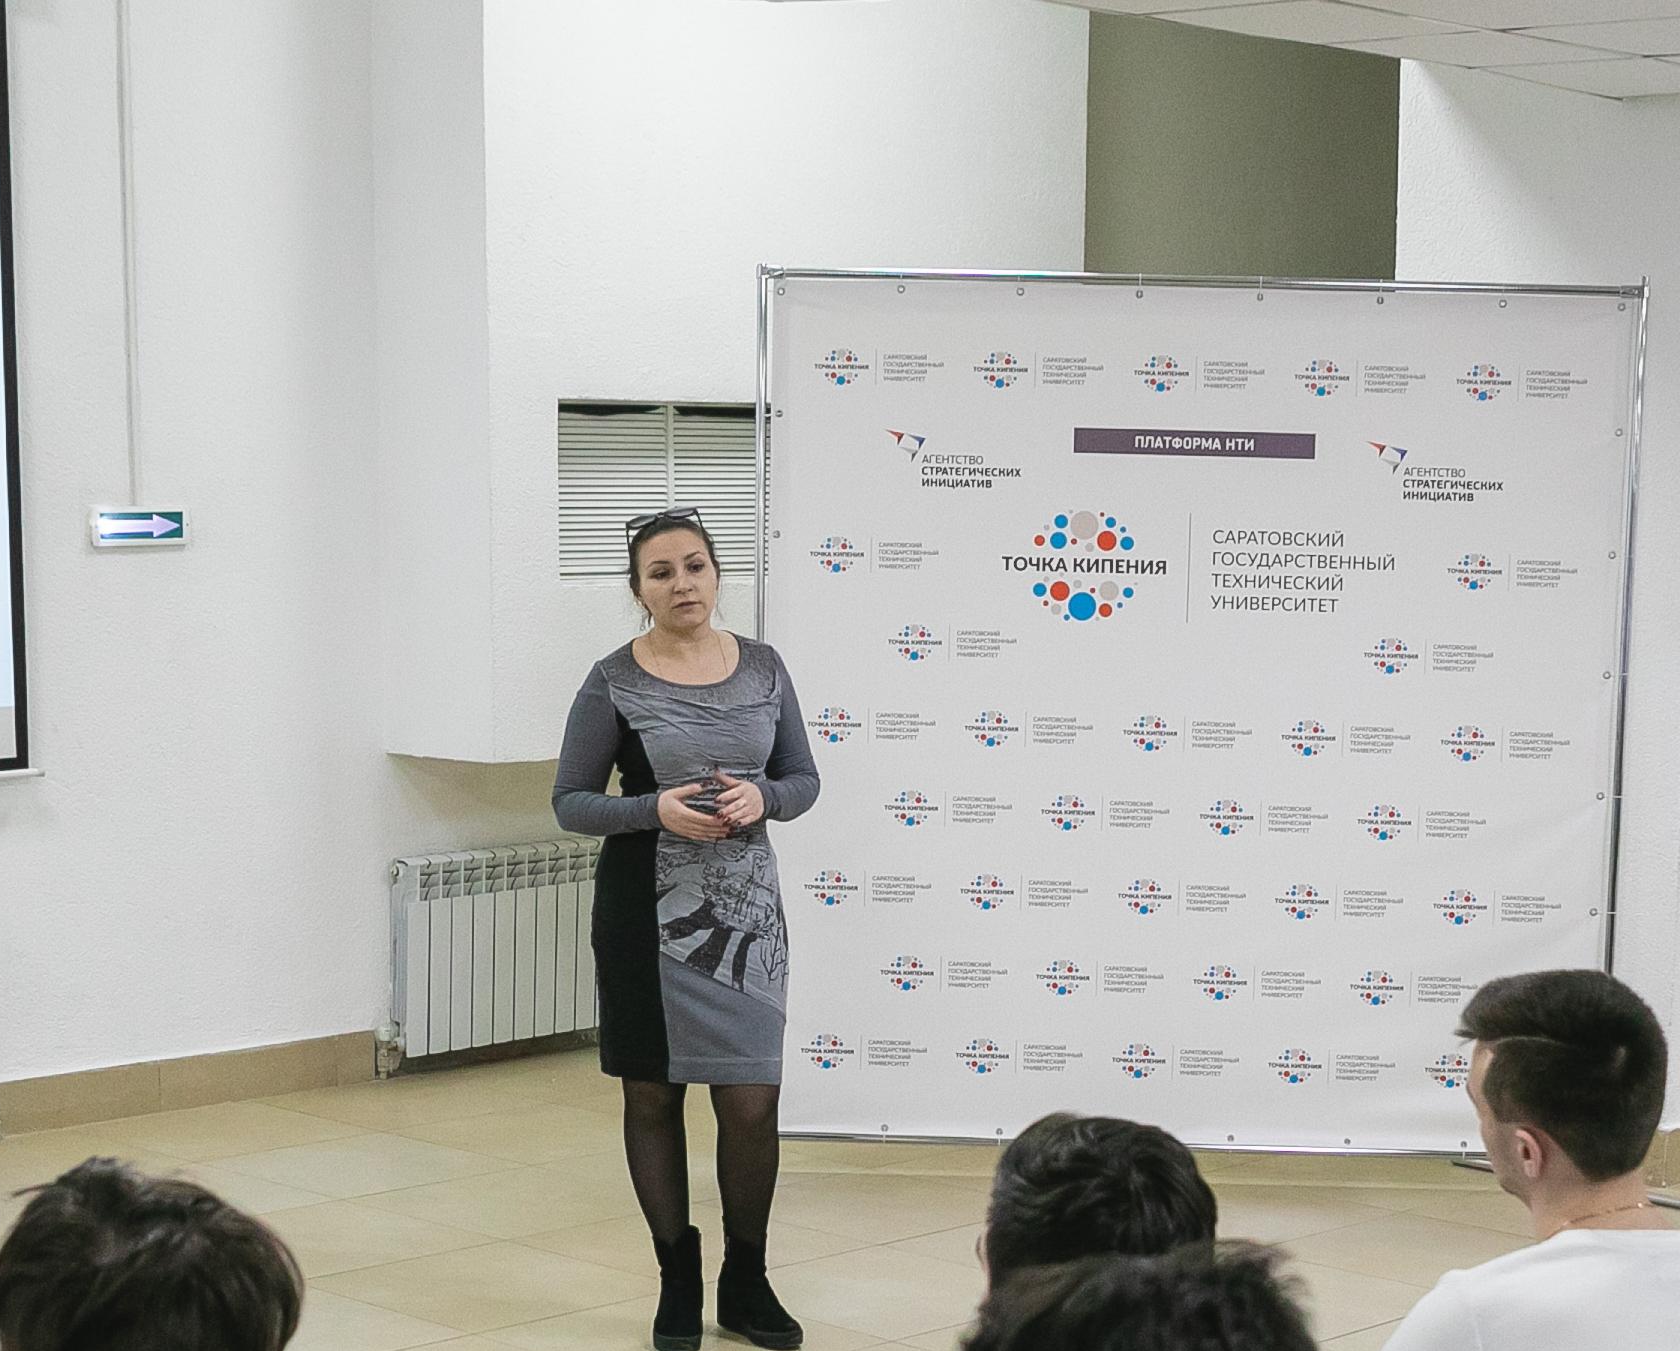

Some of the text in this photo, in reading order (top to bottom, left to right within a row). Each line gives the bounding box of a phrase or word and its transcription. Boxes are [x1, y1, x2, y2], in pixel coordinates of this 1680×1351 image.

[1134, 435, 1255, 451] ПЛАТФОРМА НТИ
[921, 454, 984, 465] АГЕНТСТВО
[921, 466, 1022, 478] СТРАТЕГИЧЕСКИХ
[1403, 467, 1466, 478] АГЕНТСТВО
[921, 477, 993, 489] ИНИЦИАТИВ
[1403, 478, 1504, 491] СТРАТЕГИЧЕСКИХ
[1403, 490, 1474, 502] ИНИЦИАТИВ
[1212, 529, 1345, 548] САРАТОВСКИЙ
[1001, 556, 1167, 575] ТОЧКА КИПЕНИЯ
[1212, 551, 1396, 572] ГОСУДАРСТВЕННЫЙ
[1211, 573, 1344, 592] ТЕХНИЧЕСКИЙ
[1210, 595, 1339, 613] УНИВЕРСИТЕТ
